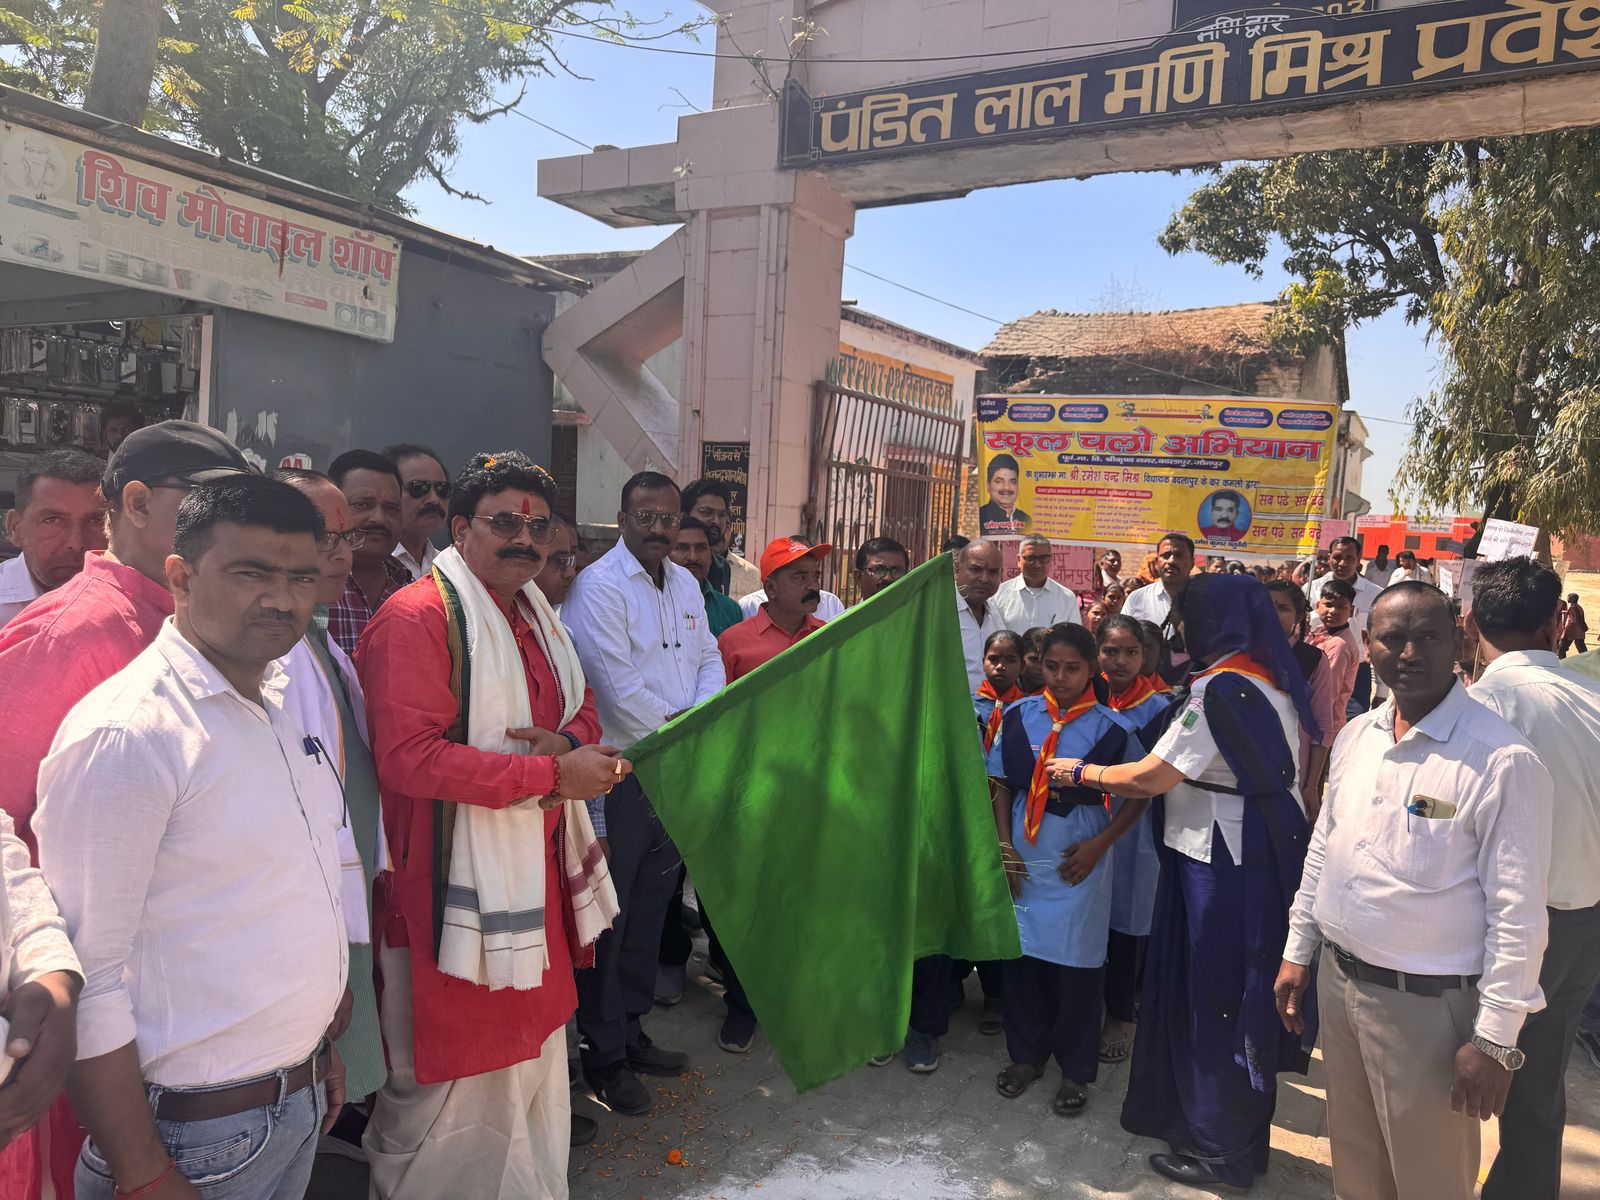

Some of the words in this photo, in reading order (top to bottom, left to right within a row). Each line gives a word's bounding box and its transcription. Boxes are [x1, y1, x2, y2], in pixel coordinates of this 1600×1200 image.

[1245, 14, 1290, 39] द्वार
[818, 90, 959, 155] पंडित
[974, 72, 1090, 136] लाल
[1103, 42, 1231, 118] मणि
[1247, 28, 1392, 103] मिश्र
[77, 149, 173, 226] शिव
[178, 184, 327, 265] मोबाइल
[331, 228, 396, 281] शॉप
[983, 430, 1075, 457] स्कूल
[1077, 425, 1158, 454] चलो
[1160, 428, 1326, 461] अभियान
[1069, 466, 1080, 480] श्री
[1081, 467, 1101, 482] रमेश
[1104, 469, 1120, 483] चन्द्र
[1122, 468, 1141, 484] मिश्र
[1171, 476, 1198, 488] बदलापुर
[1201, 474, 1208, 485] के
[1209, 478, 1220, 486] कर
[1259, 494, 1274, 506] सब
[1252, 525, 1268, 536] सब
